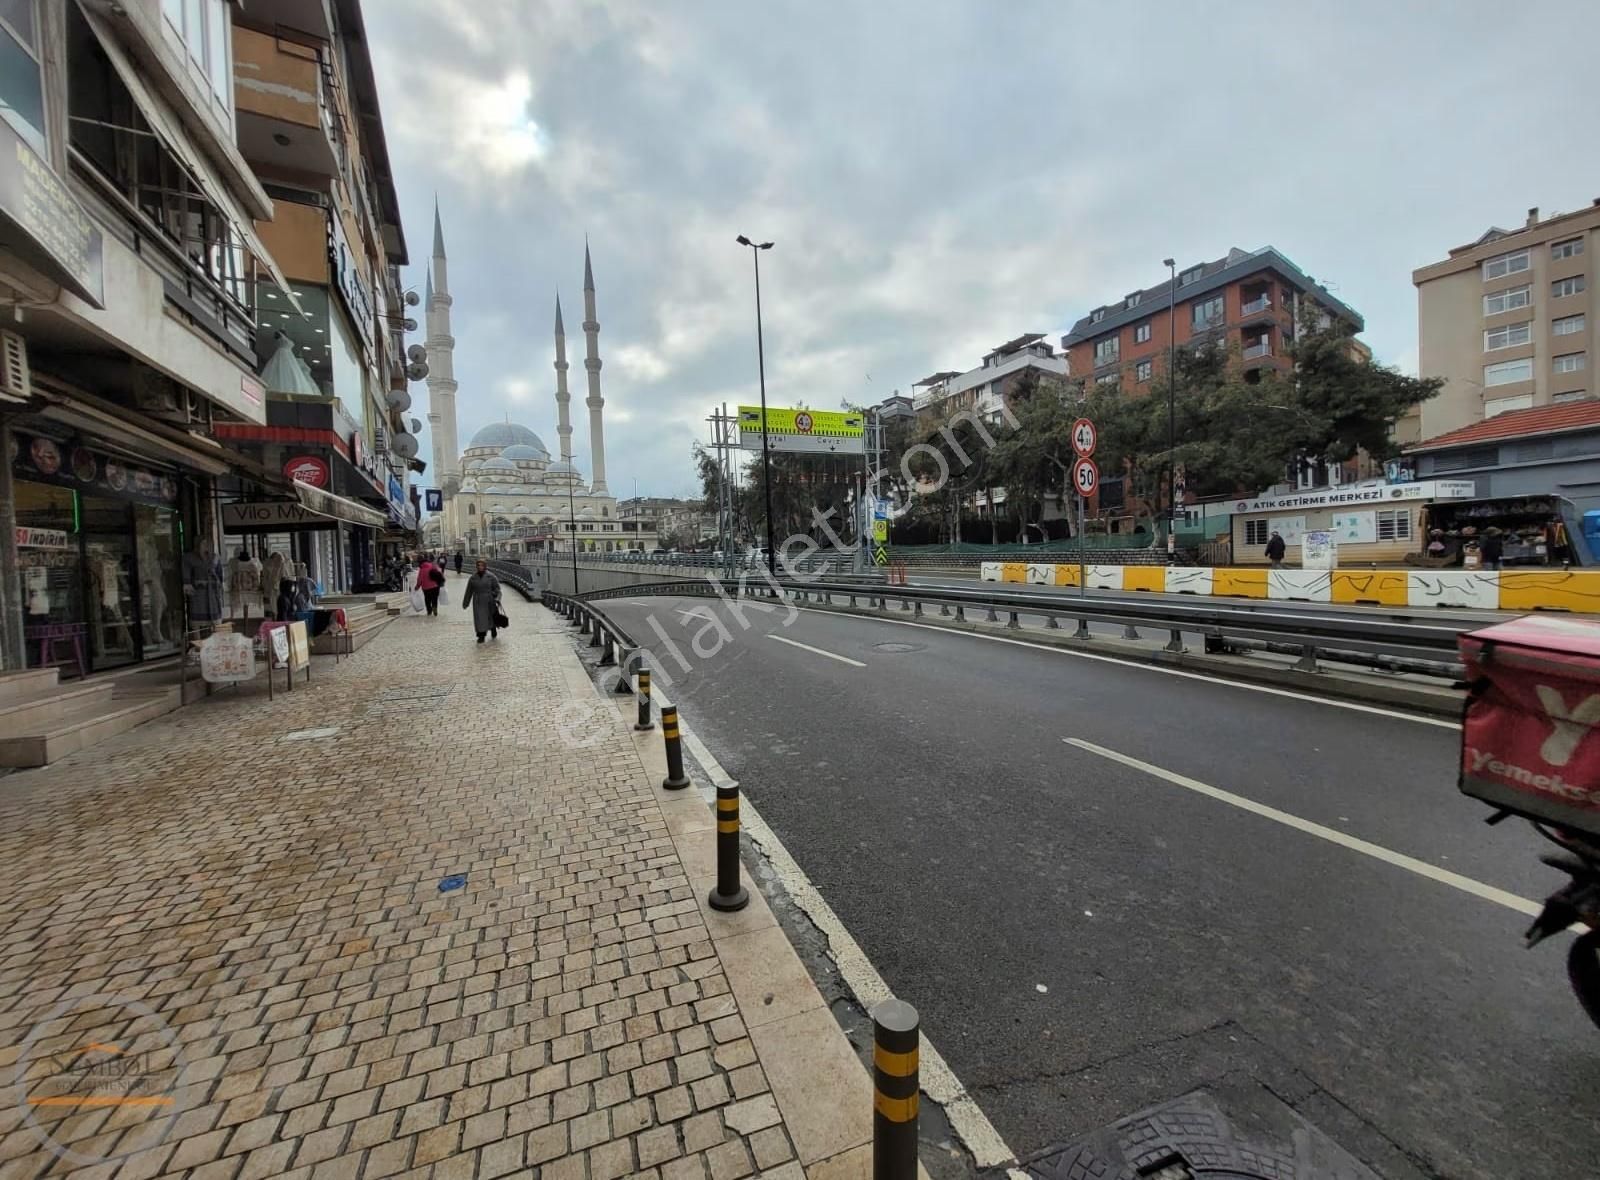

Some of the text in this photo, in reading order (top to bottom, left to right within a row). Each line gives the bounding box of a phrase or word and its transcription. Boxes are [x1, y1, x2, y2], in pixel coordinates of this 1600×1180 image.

[1080, 469, 1094, 486] 50
[1278, 496, 1326, 507] GETİRME
[1329, 488, 1383, 503] MERKEZİ
[234, 505, 271, 520] Vilo
[29, 530, 66, 547] İNDİRİM
